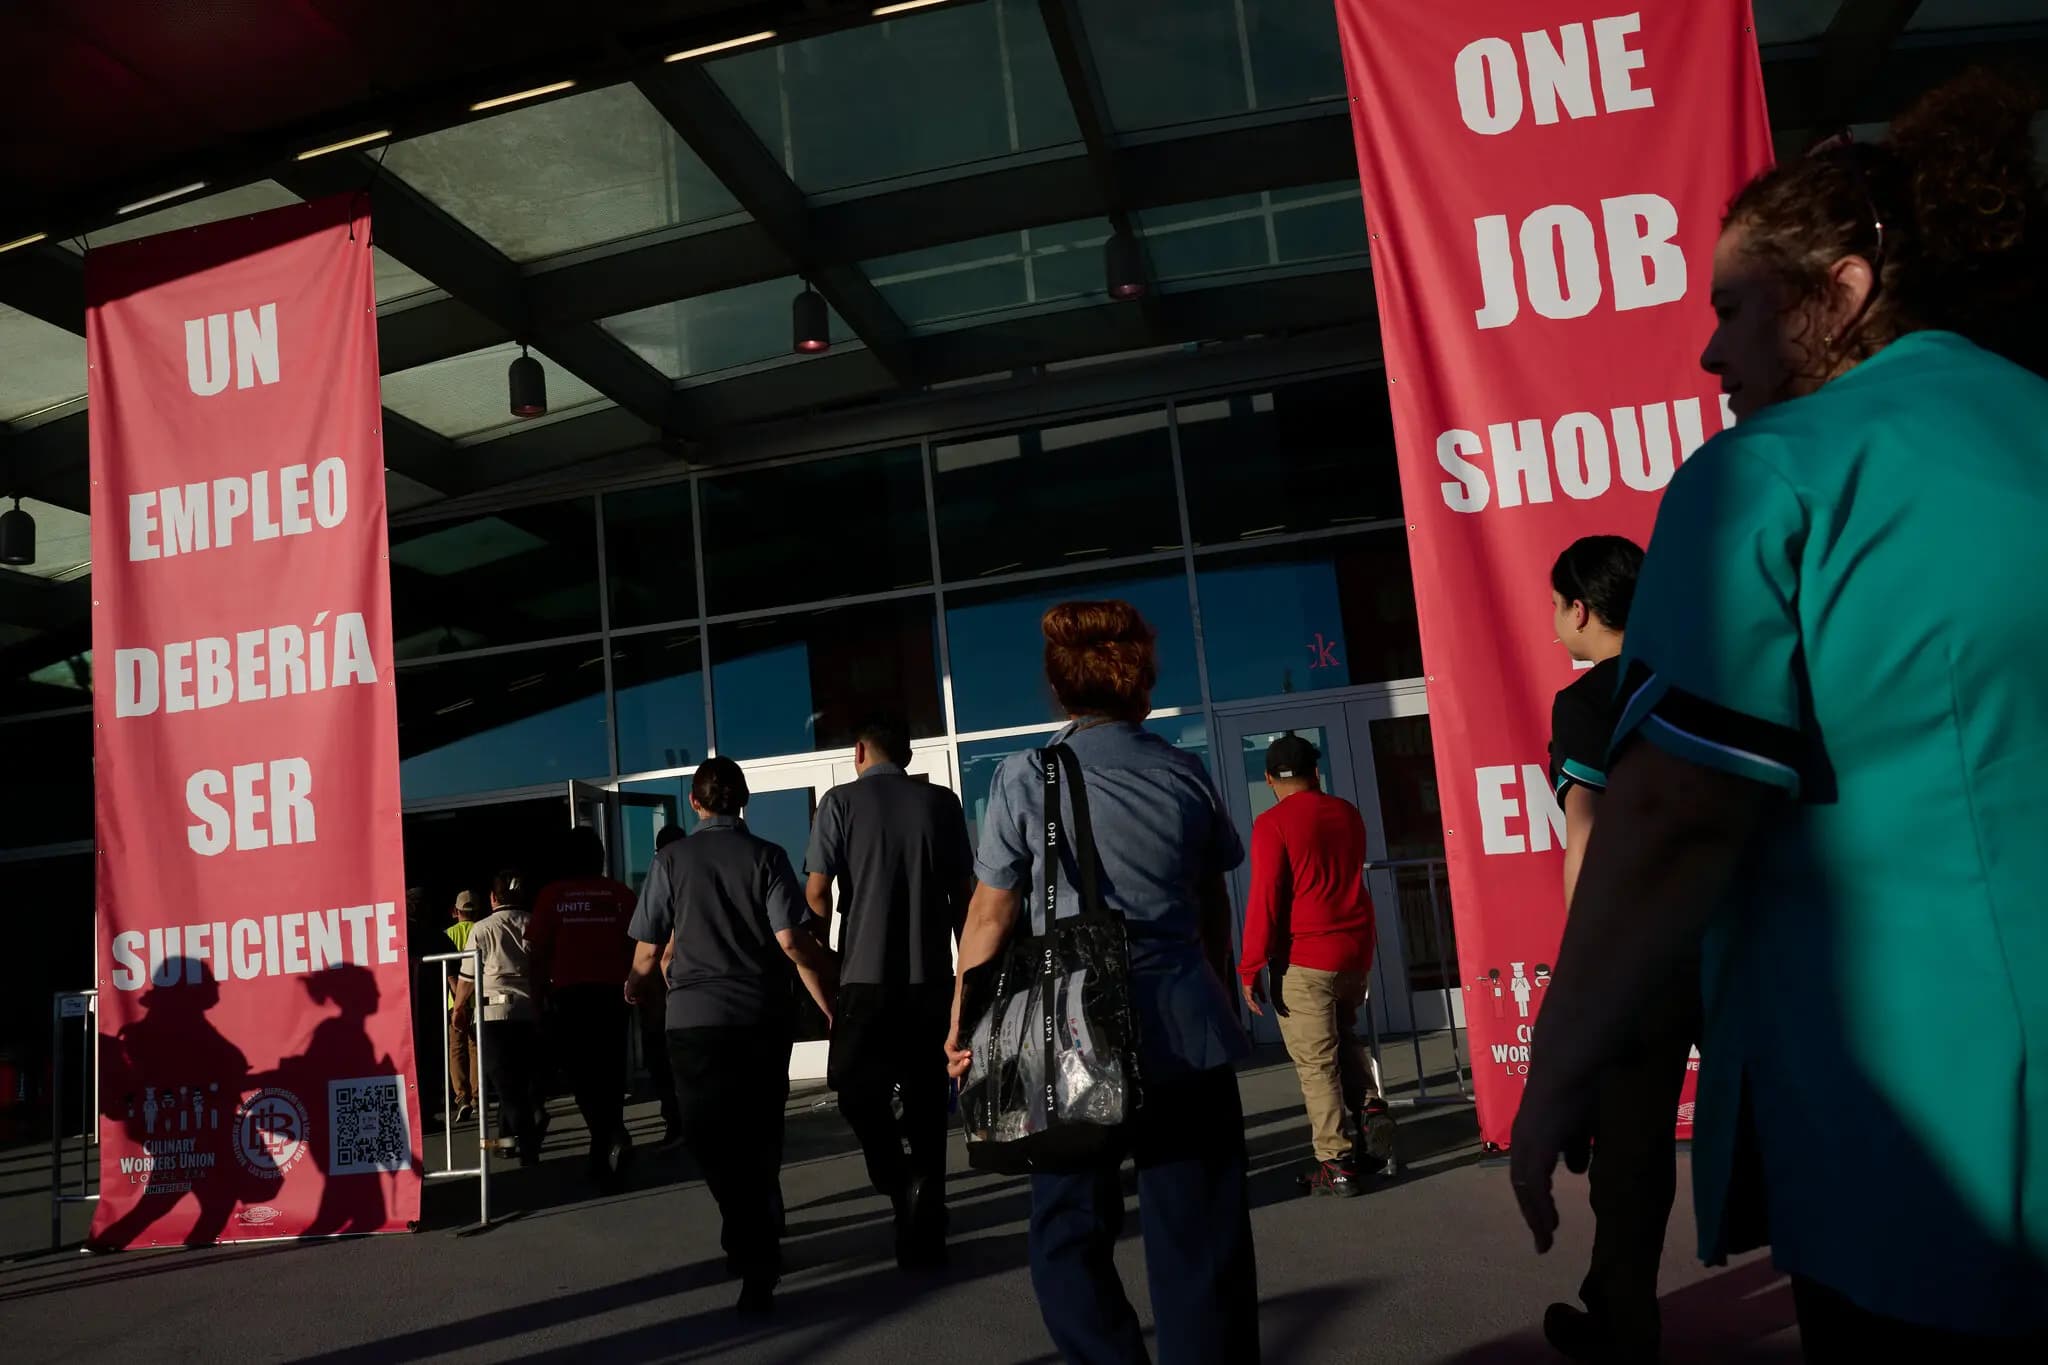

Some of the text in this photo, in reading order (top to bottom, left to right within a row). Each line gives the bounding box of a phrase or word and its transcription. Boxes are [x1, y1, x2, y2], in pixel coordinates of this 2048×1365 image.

[1454, 11, 1655, 135] ONE
[1474, 193, 1687, 330] JOB
[184, 302, 280, 396] UN
[128, 456, 348, 562] EMPLEO
[186, 757, 316, 856] SER
[112, 901, 399, 991] SUFICIENTE
[120, 1152, 216, 1174] WORKERS UNION
[143, 1137, 197, 1156] CULINARY
